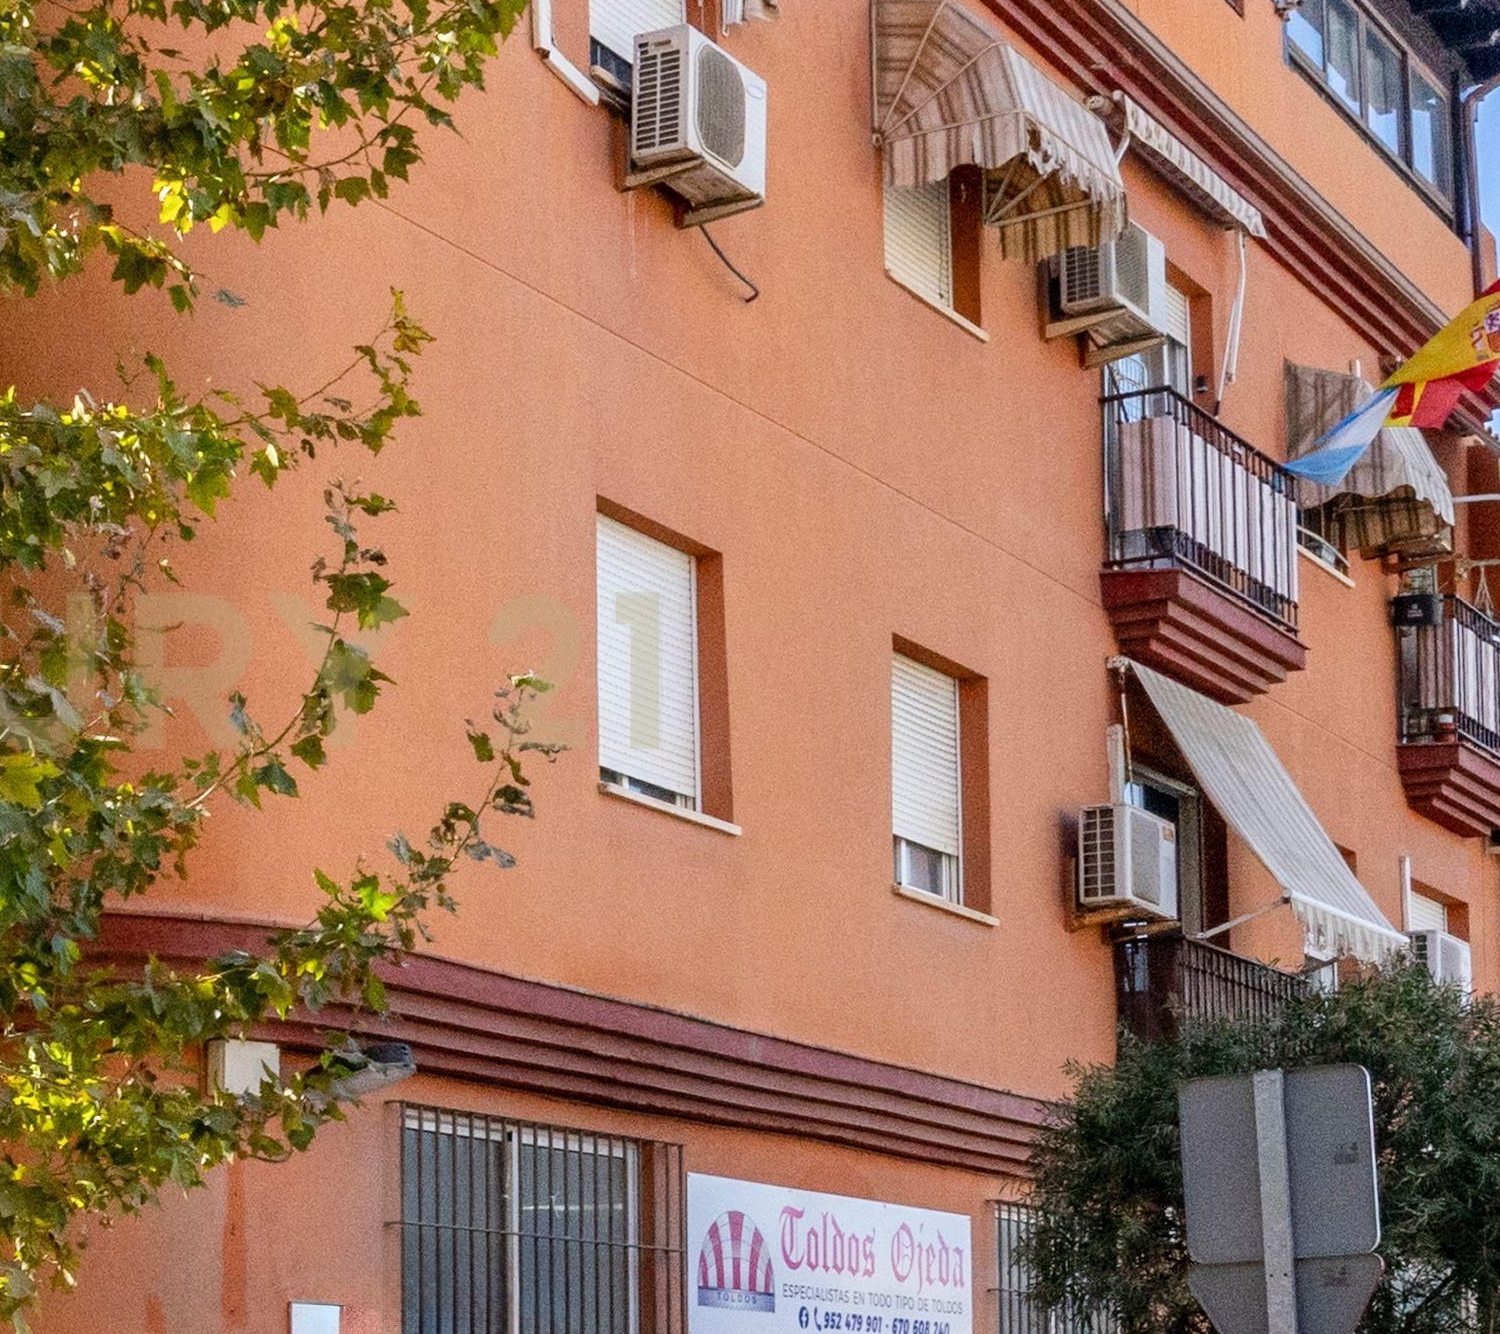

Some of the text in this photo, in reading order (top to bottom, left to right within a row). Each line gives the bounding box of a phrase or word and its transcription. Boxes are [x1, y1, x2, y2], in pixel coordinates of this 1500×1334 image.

[779, 1206, 966, 1295] Toldos Ojeda
[717, 1293, 757, 1305] TOLDOS
[782, 1283, 964, 1315] ESPECIALISTAS EN TODO TIPO DE TOLDOS
[823, 1312, 842, 1330] 952
[845, 1314, 863, 1332] 479
[866, 1315, 882, 1334] 901
